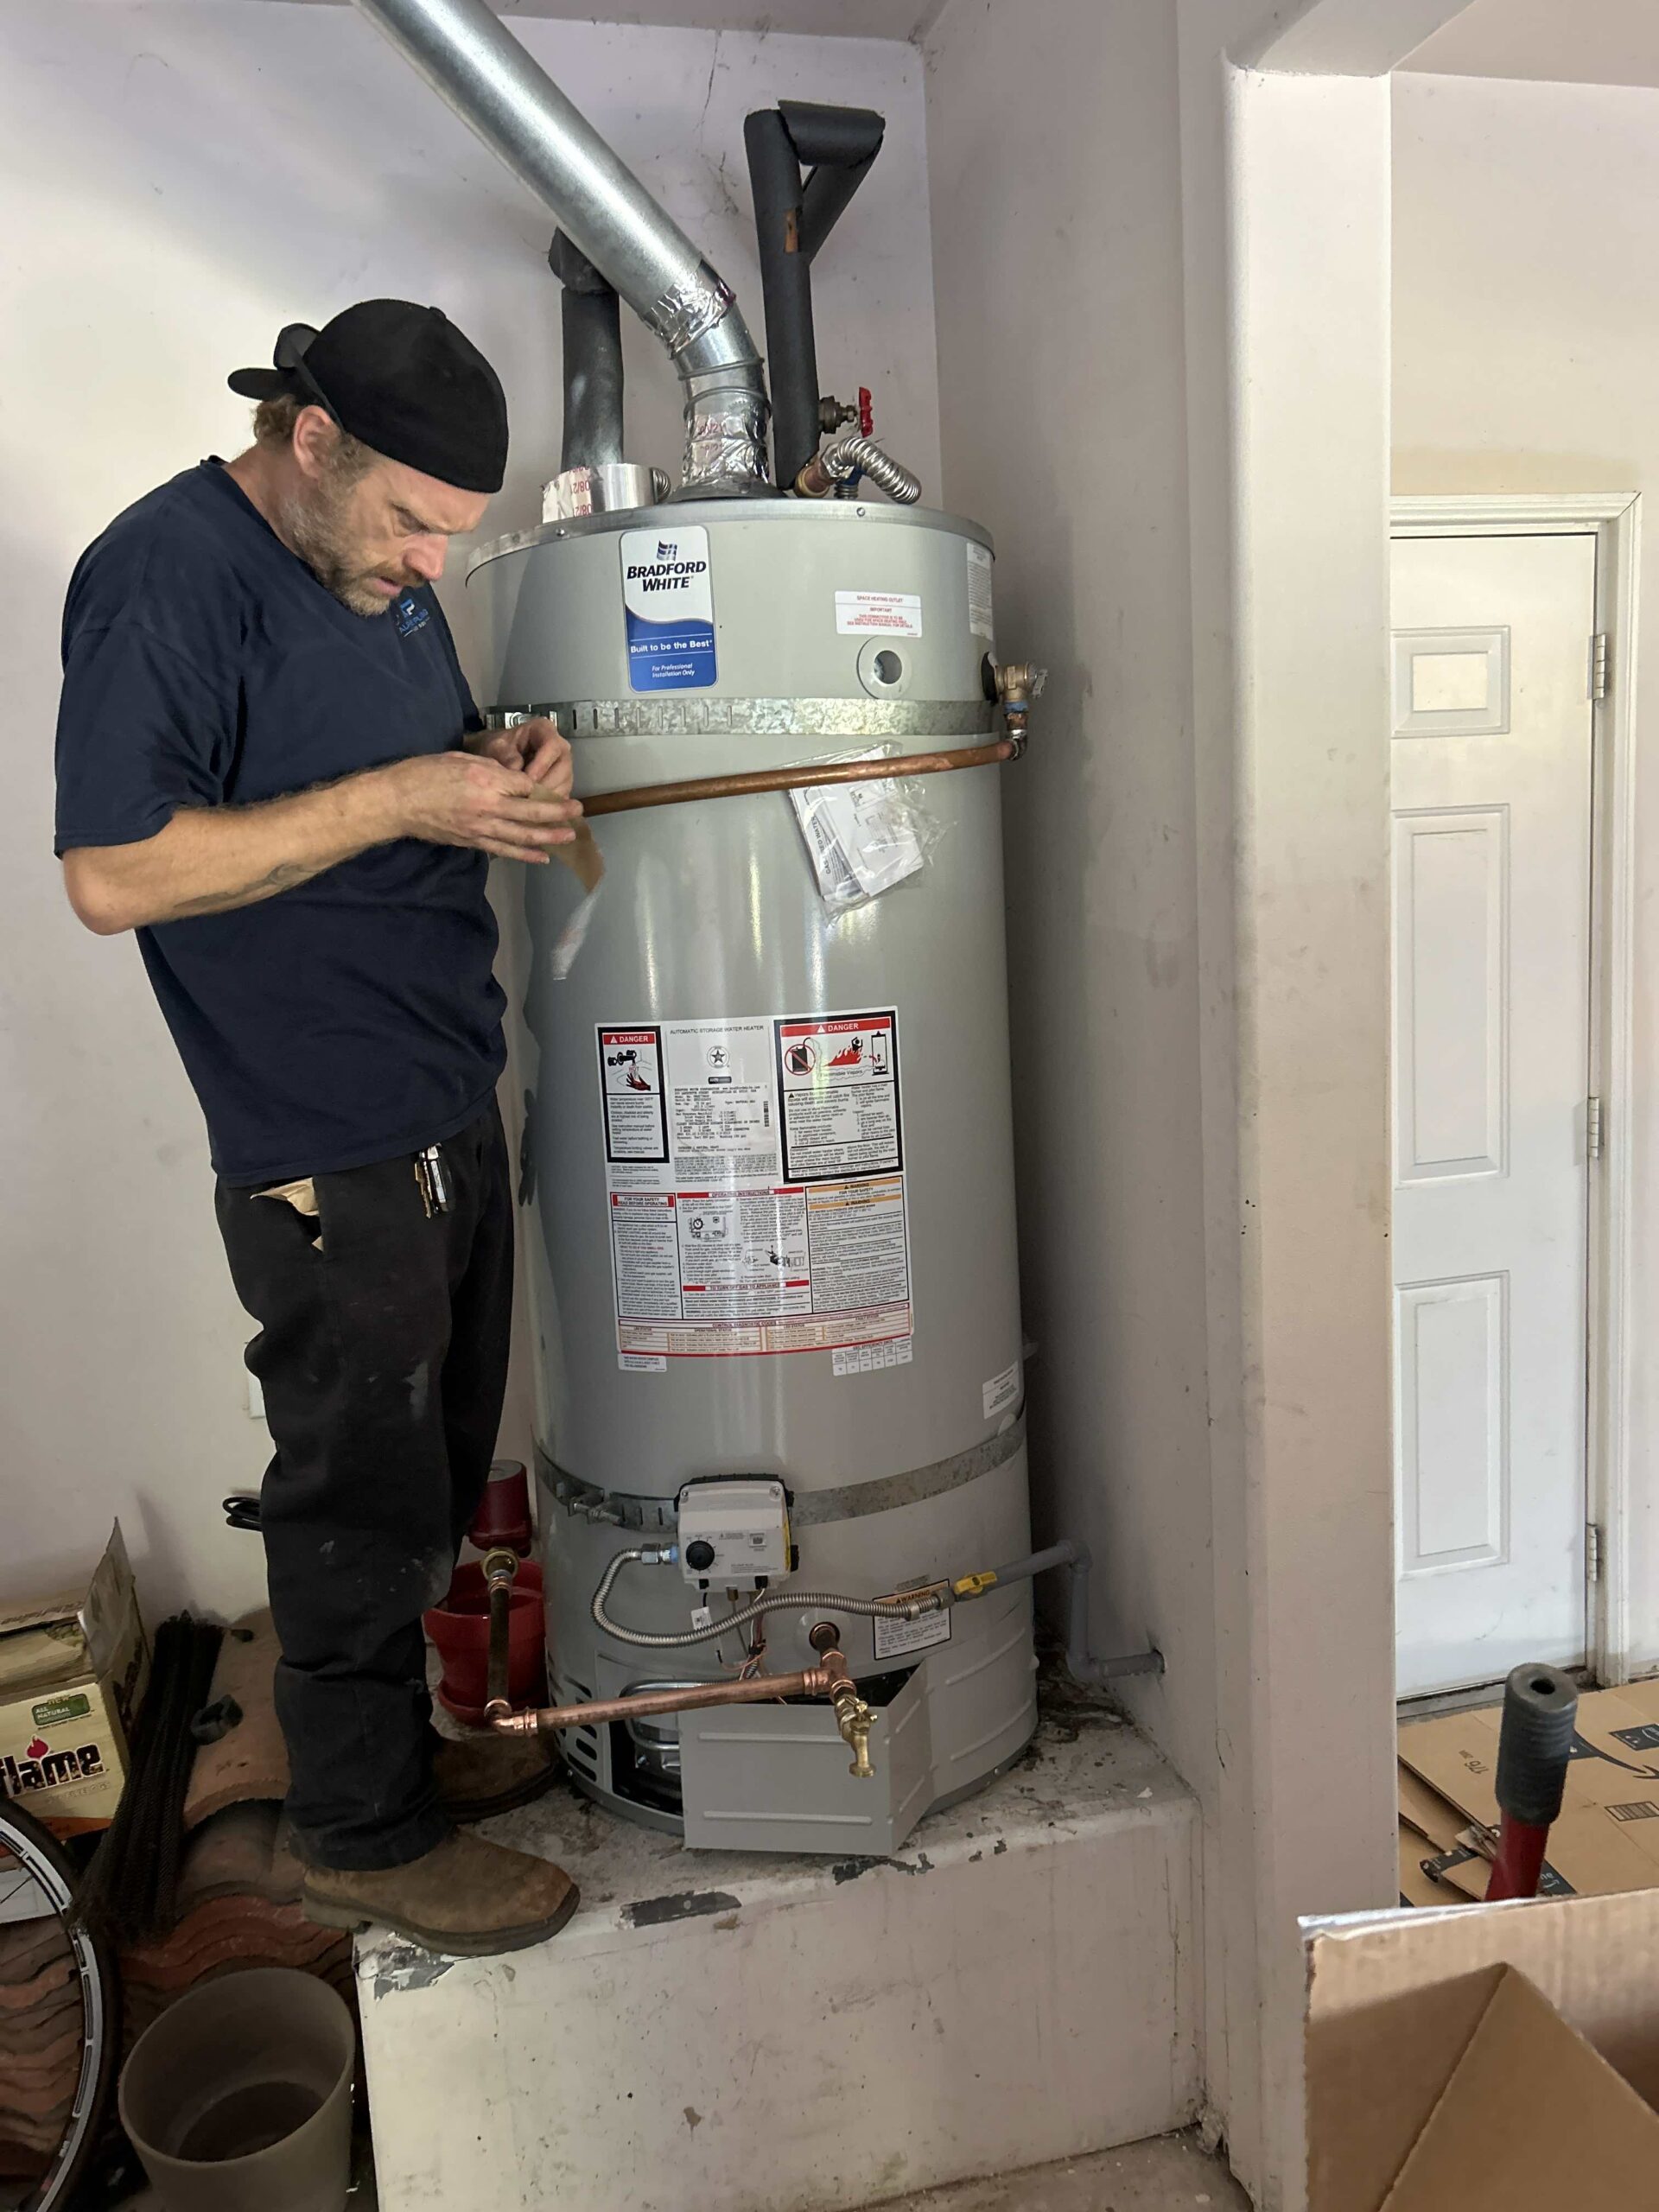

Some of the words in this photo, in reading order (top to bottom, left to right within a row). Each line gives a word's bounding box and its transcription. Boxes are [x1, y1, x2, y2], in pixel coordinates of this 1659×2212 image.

[627, 562, 707, 579] BRADFORD
[642, 576, 690, 592] WHITE
[662, 663, 692, 671] Professional
[652, 670, 681, 678] Installation
[828, 1023, 858, 1032] DANGER
[901, 1590, 931, 1601] WARNING
[37, 1707, 71, 1719] NATURAL
